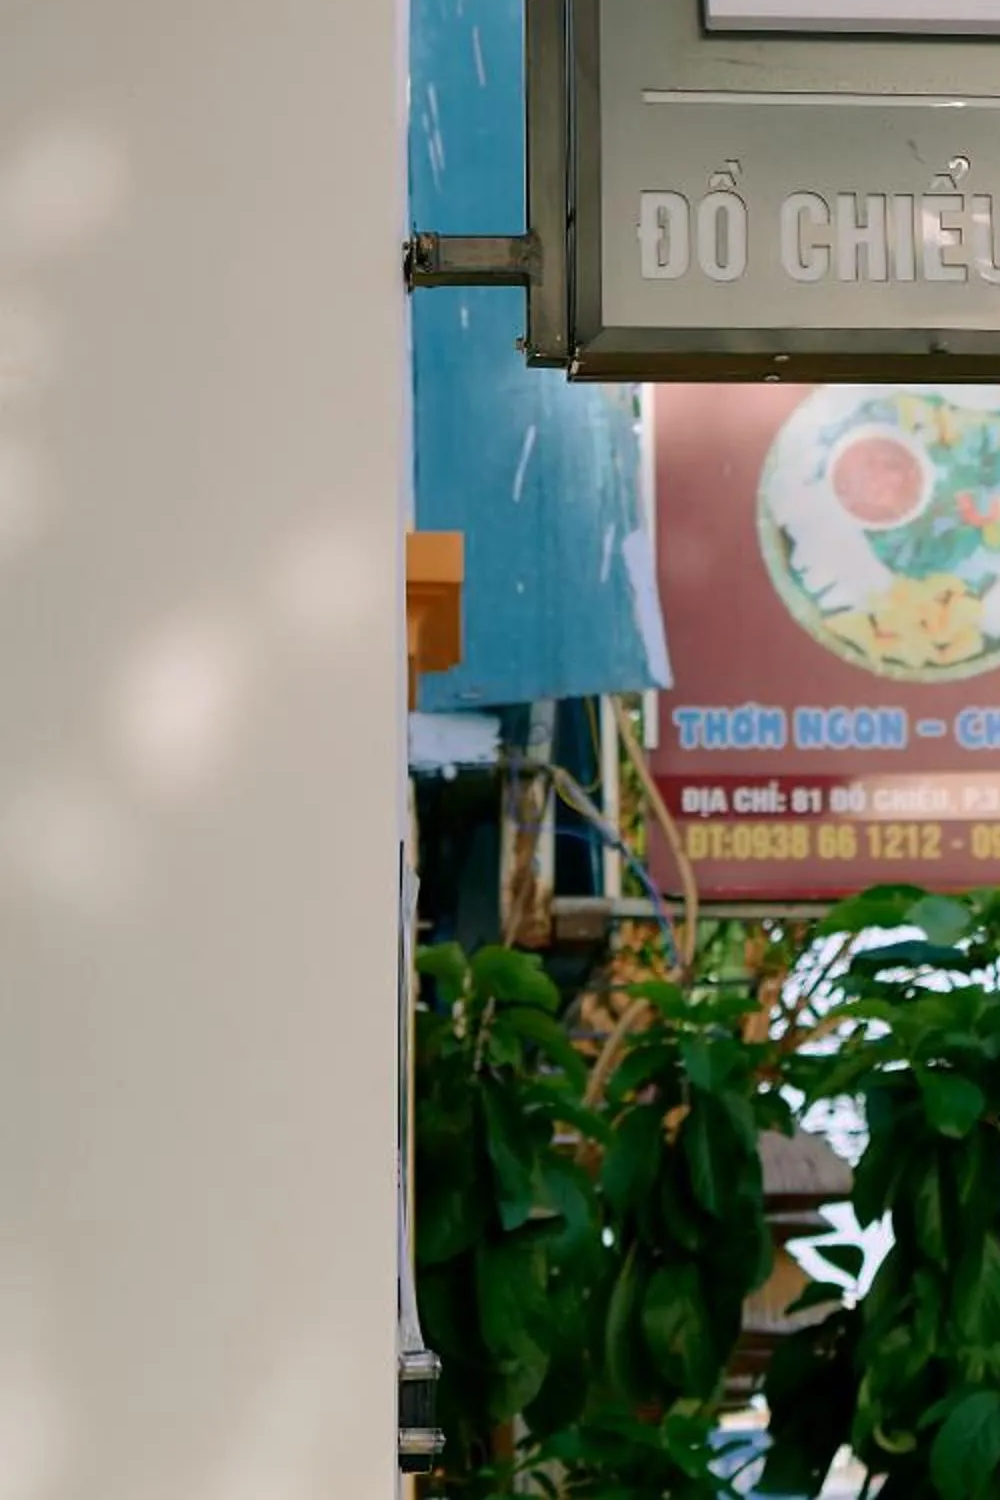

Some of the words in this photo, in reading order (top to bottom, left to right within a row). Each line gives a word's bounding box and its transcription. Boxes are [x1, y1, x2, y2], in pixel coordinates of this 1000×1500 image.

[636, 159, 748, 283] ĐỒ
[794, 708, 907, 749] NGON
[682, 786, 728, 817] ĐỊA
[819, 825, 856, 859] 66
[868, 825, 941, 859] 1212
